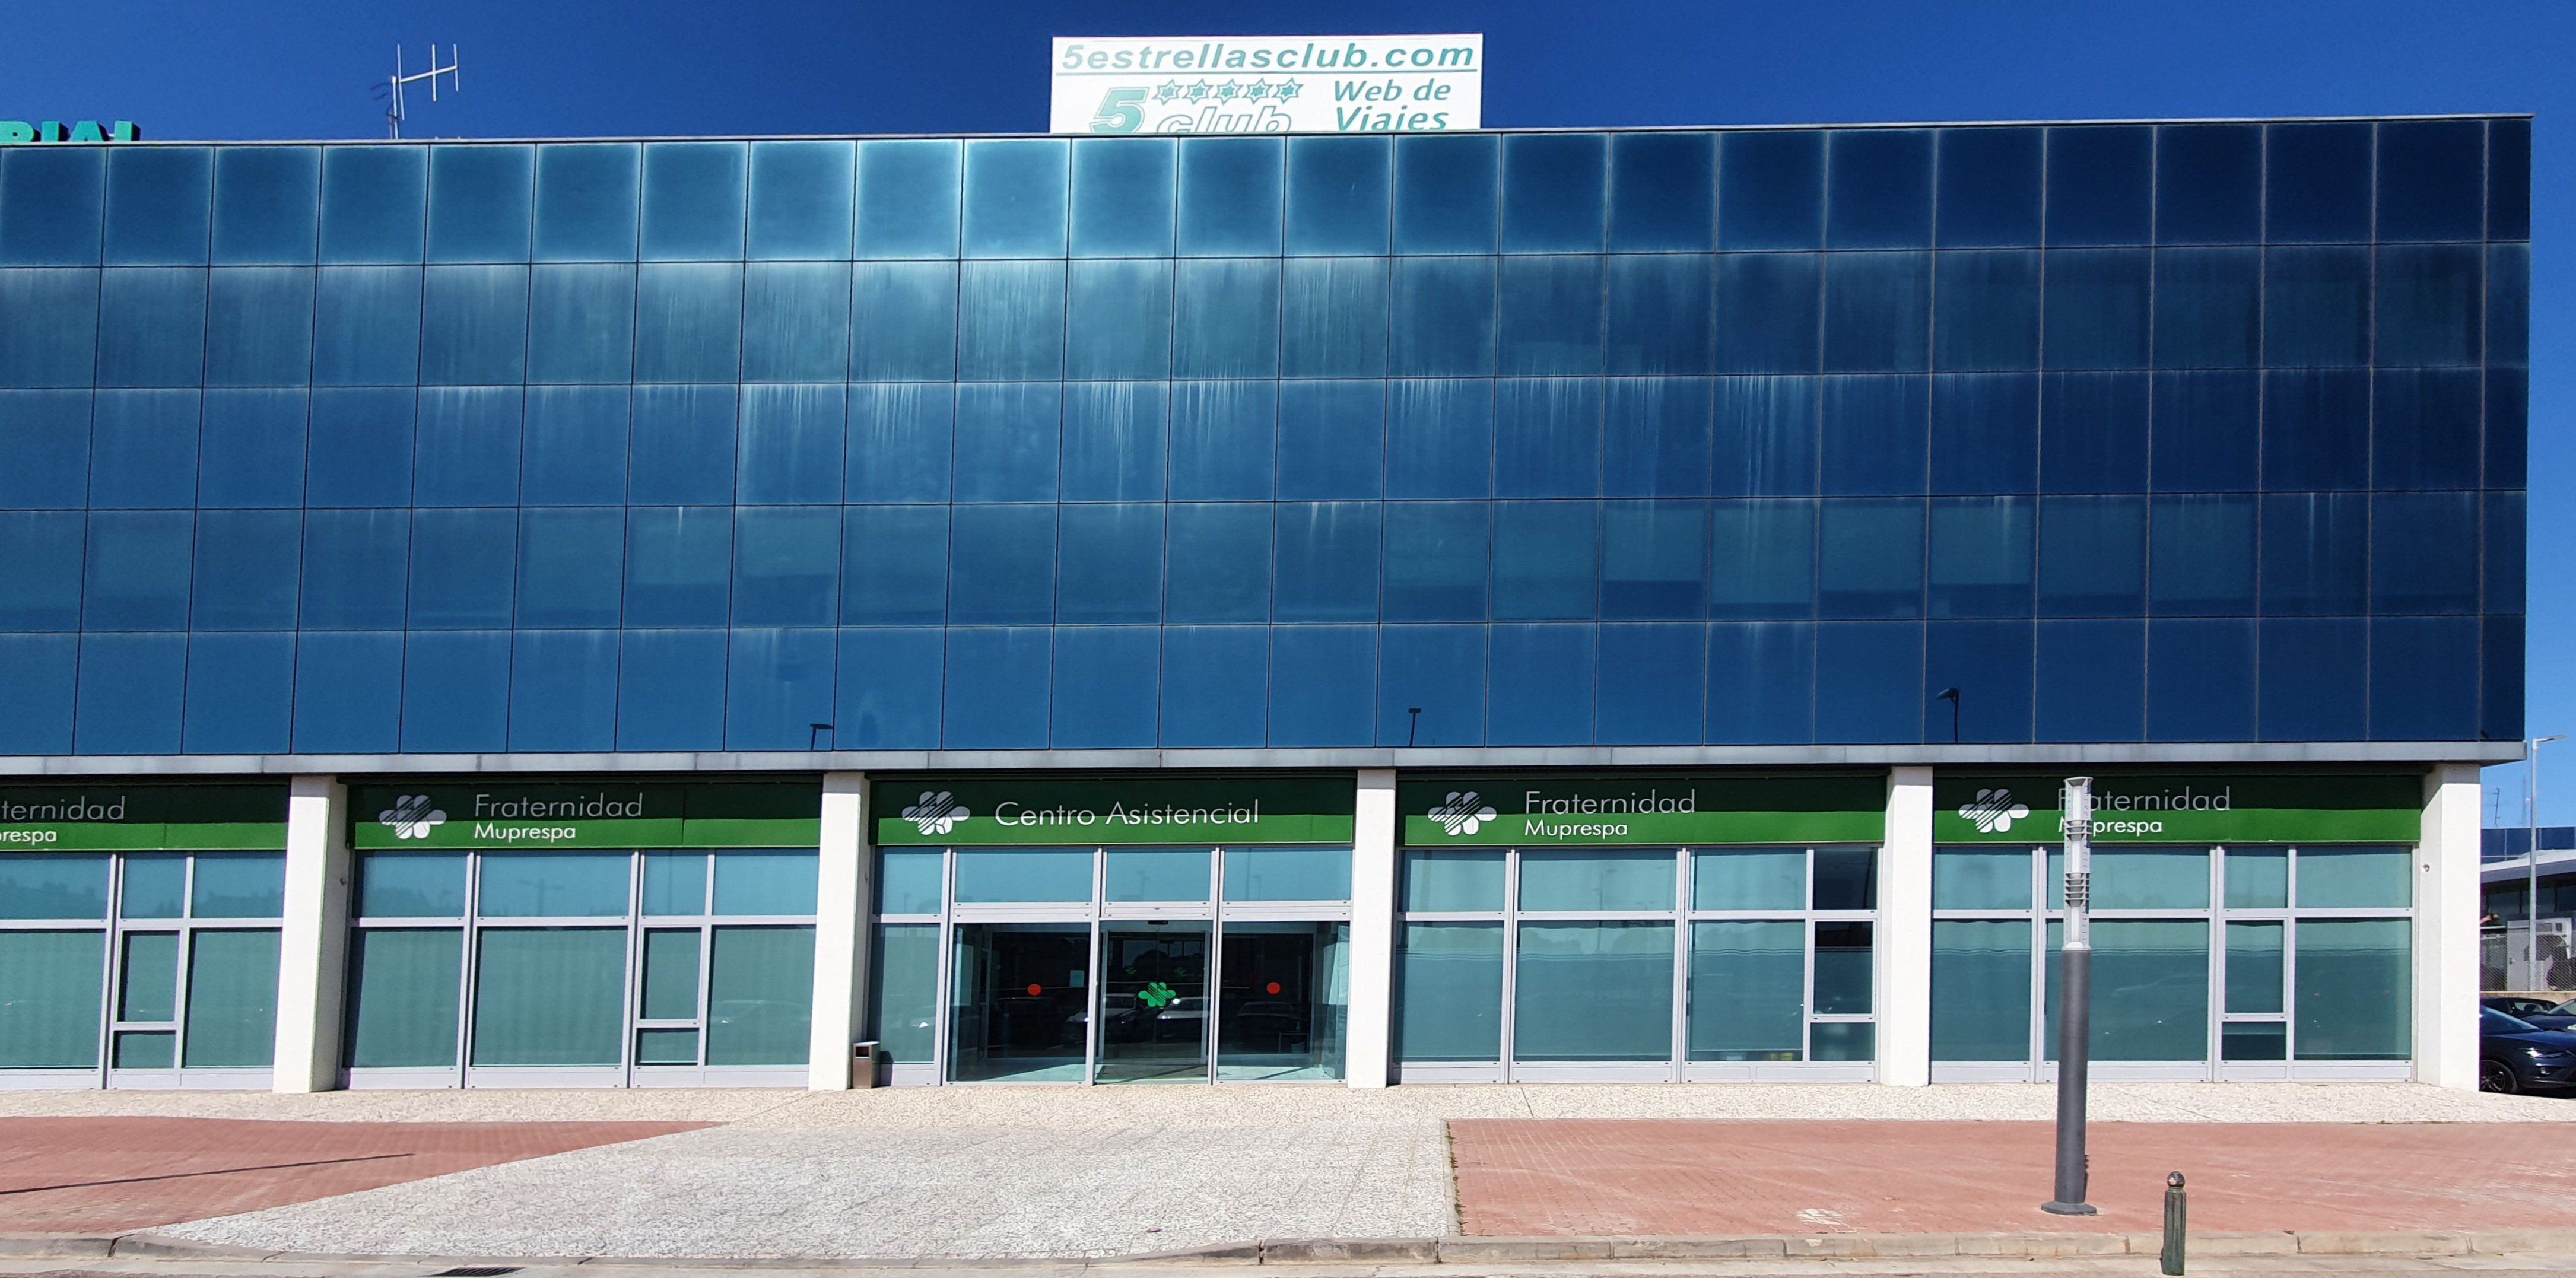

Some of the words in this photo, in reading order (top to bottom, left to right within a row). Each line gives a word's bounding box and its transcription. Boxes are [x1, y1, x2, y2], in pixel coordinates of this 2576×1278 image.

[1062, 43, 1474, 69] 5estrellasclub.com
[1335, 78, 1402, 101] Web
[1414, 78, 1451, 101] de
[475, 792, 643, 818] Fraternidad
[1526, 788, 1695, 815] Fraternidad
[2058, 786, 2231, 811] Faternidad
[995, 802, 1096, 825] Centro
[1105, 799, 1259, 825] Asistencial
[0, 831, 57, 845] respa
[474, 822, 576, 843] Muprespa
[1524, 819, 1628, 840] Muprespa
